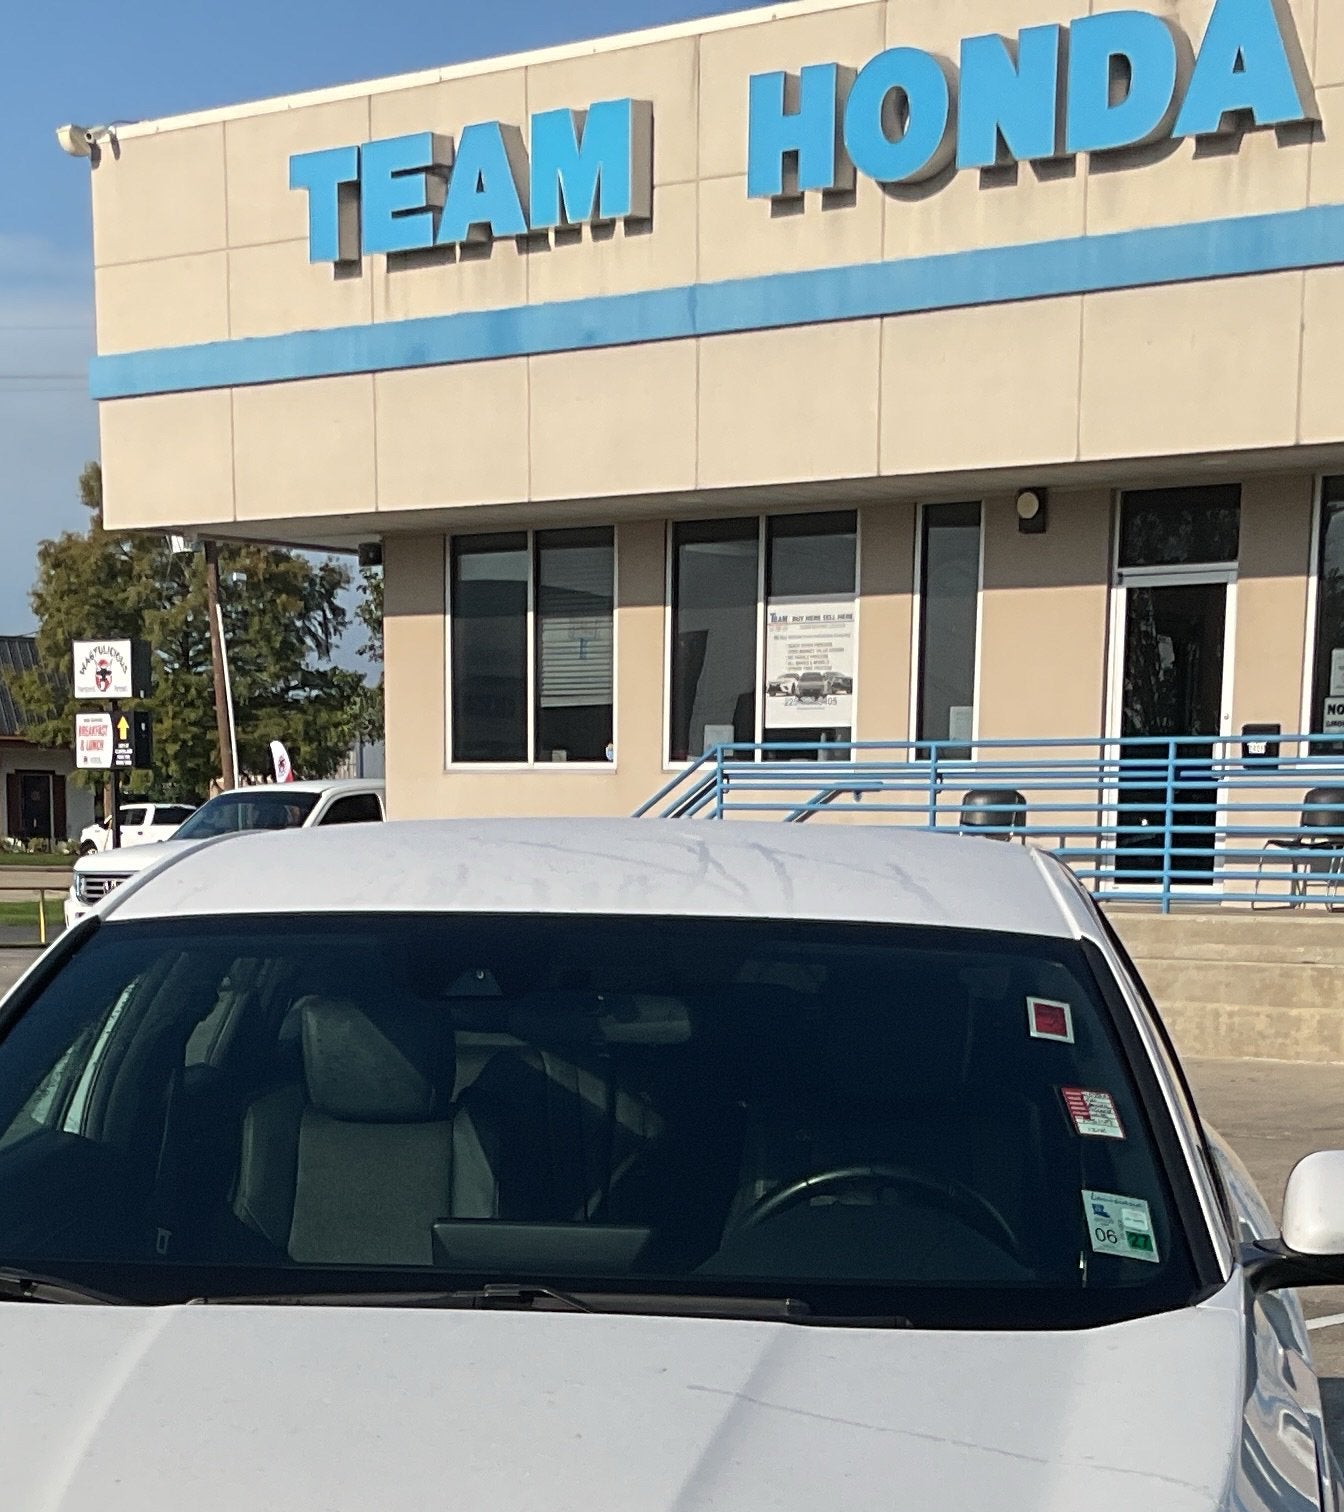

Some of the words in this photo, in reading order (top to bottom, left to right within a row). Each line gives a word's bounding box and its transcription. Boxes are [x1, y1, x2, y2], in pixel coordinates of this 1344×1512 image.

[289, 97, 646, 265] TEAM
[747, 0, 1312, 201] HONDA
[1095, 1227, 1118, 1245] 06
